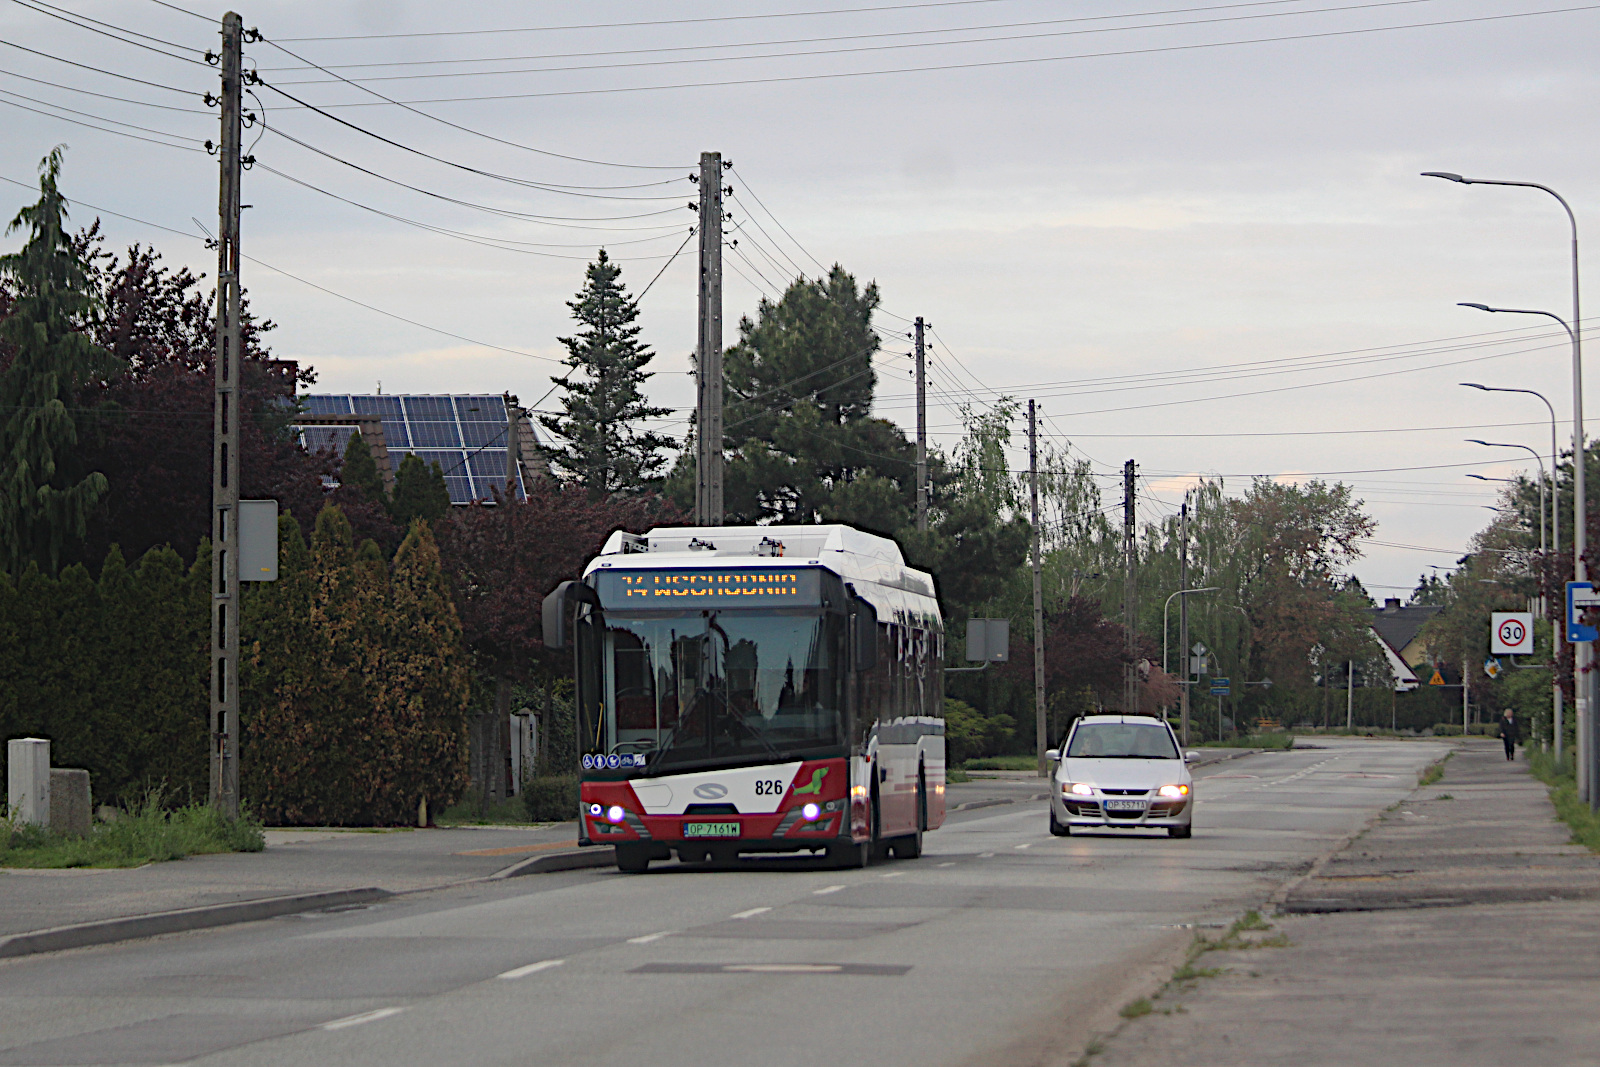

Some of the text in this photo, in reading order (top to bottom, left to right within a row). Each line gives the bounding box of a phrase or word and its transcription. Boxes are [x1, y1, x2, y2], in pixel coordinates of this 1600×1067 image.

[622, 576, 648, 597] 14
[1503, 626, 1522, 640] 30
[755, 779, 783, 796] 826
[690, 824, 737, 834] OP 7161W
